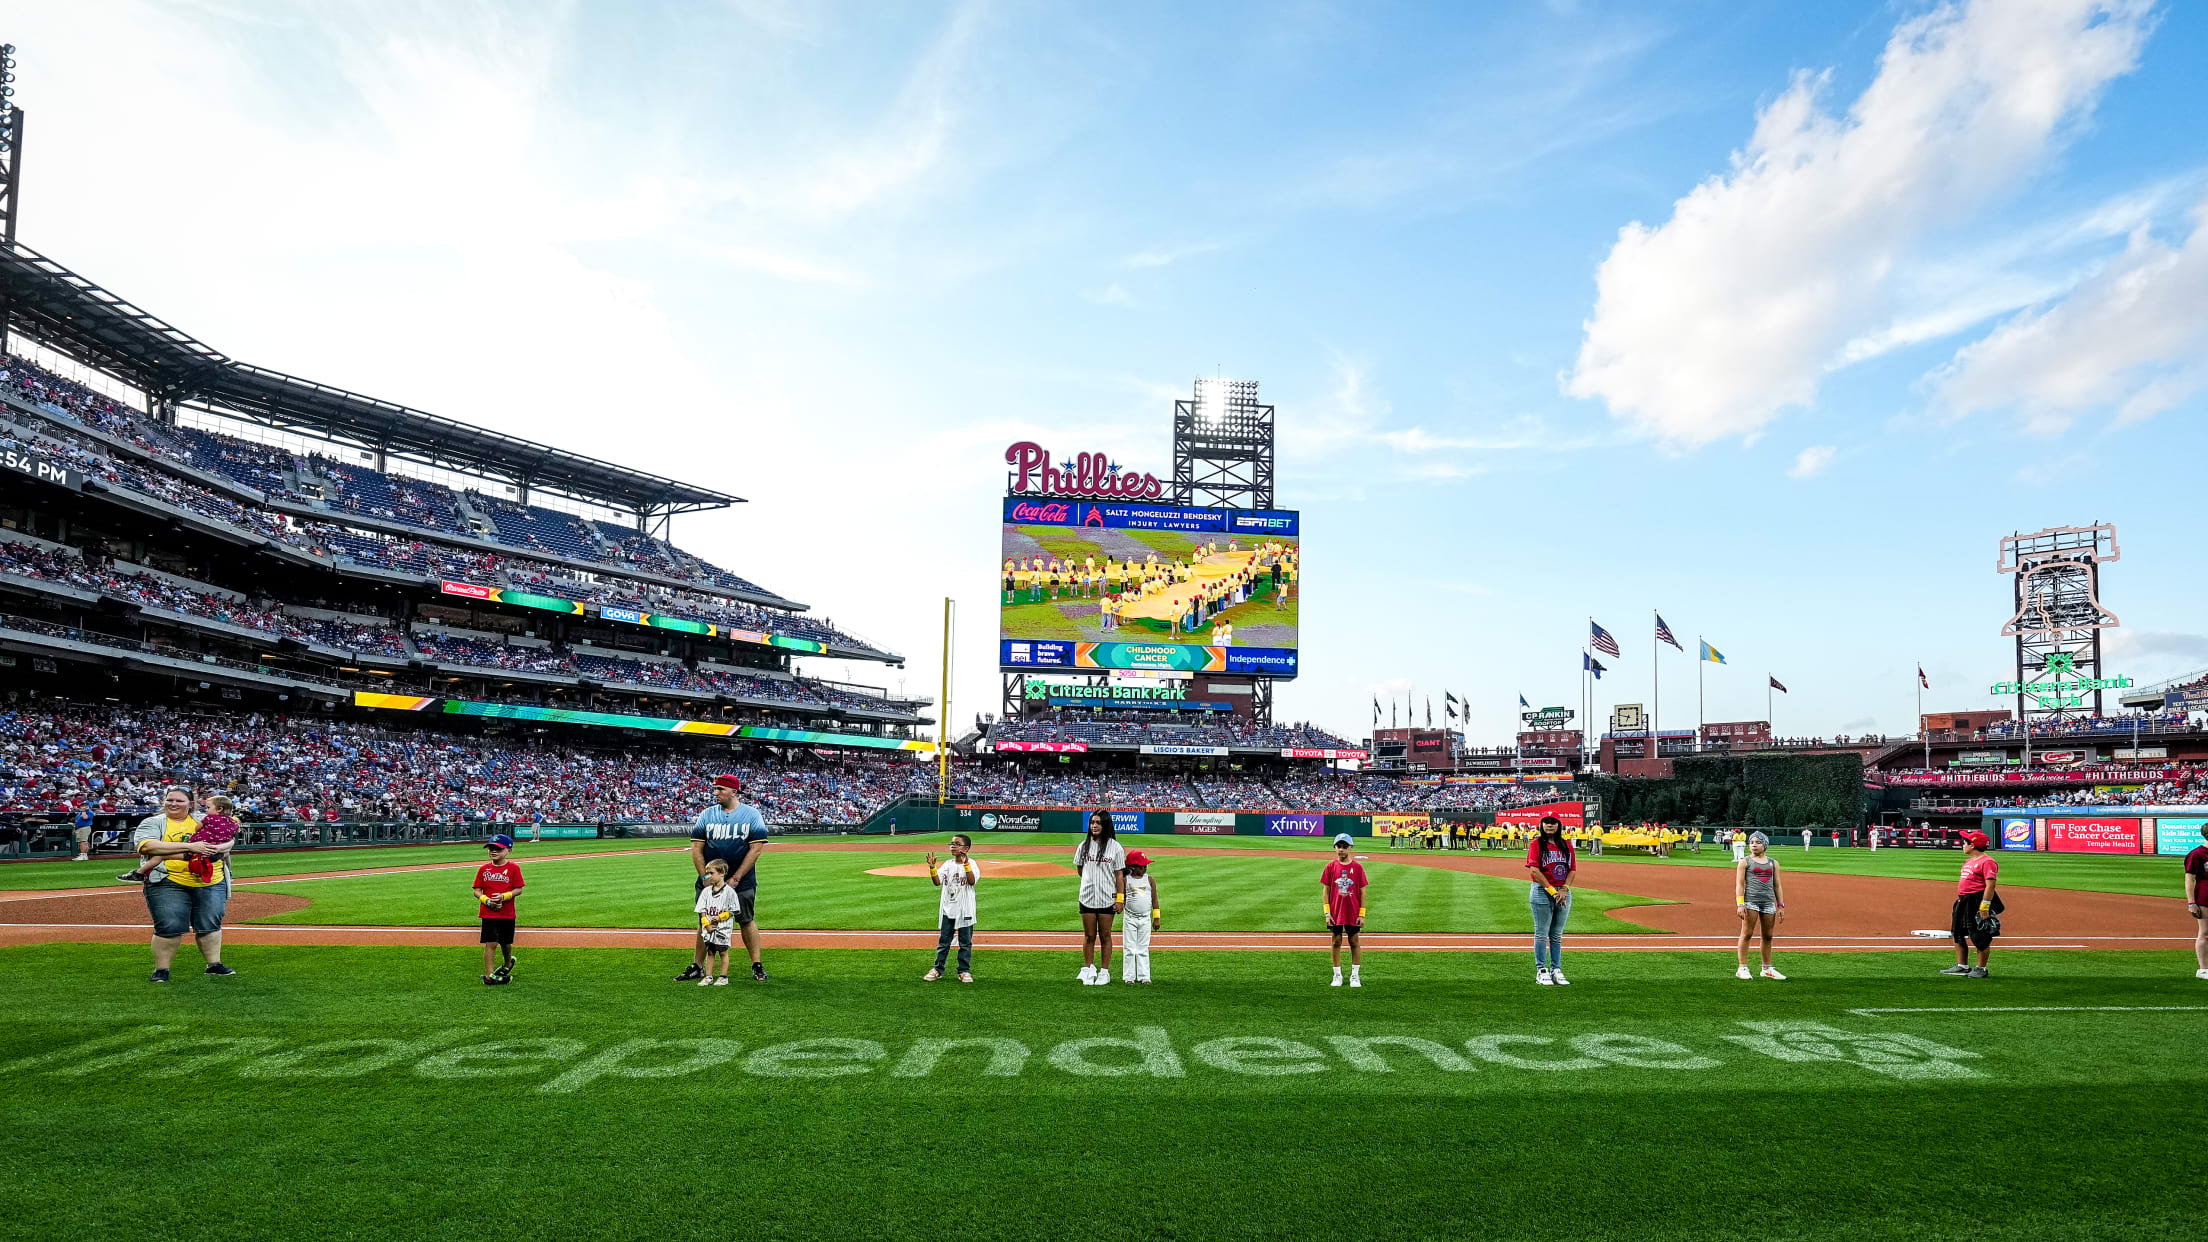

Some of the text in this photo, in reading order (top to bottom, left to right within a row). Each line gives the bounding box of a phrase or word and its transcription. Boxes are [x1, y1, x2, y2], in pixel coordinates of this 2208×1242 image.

[38, 462, 66, 484] PM
[1005, 441, 1162, 498] Phillies
[1012, 502, 1070, 522] Coca-Cola
[1131, 511, 1180, 519] MONGELUZZI
[1183, 513, 1222, 521] BENDESKY
[606, 610, 634, 620] GOYA
[1038, 644, 1064, 652] Building
[1126, 646, 1176, 654] CHILDHOOD
[1230, 655, 1285, 665] Independence
[1994, 674, 2129, 694] Citizens Bank
[1050, 684, 1186, 700] Citizens Bank Park
[2038, 693, 2082, 708] Park
[1940, 774, 2005, 782] #HITTHEBUDS
[2020, 772, 2070, 781] Budweiser
[2085, 771, 2164, 780] #HITTHEBUDS
[998, 814, 1040, 824] NovaCare
[1186, 814, 1224, 824] Yuengling
[670, 825, 694, 834] NETW
[1271, 817, 1318, 833] xfinity
[2068, 823, 2087, 832] Fox
[2089, 823, 2122, 832] Chase
[706, 824, 750, 840] PHILLY
[2102, 832, 2135, 840] Center
[0, 1024, 1722, 1094] Independence
